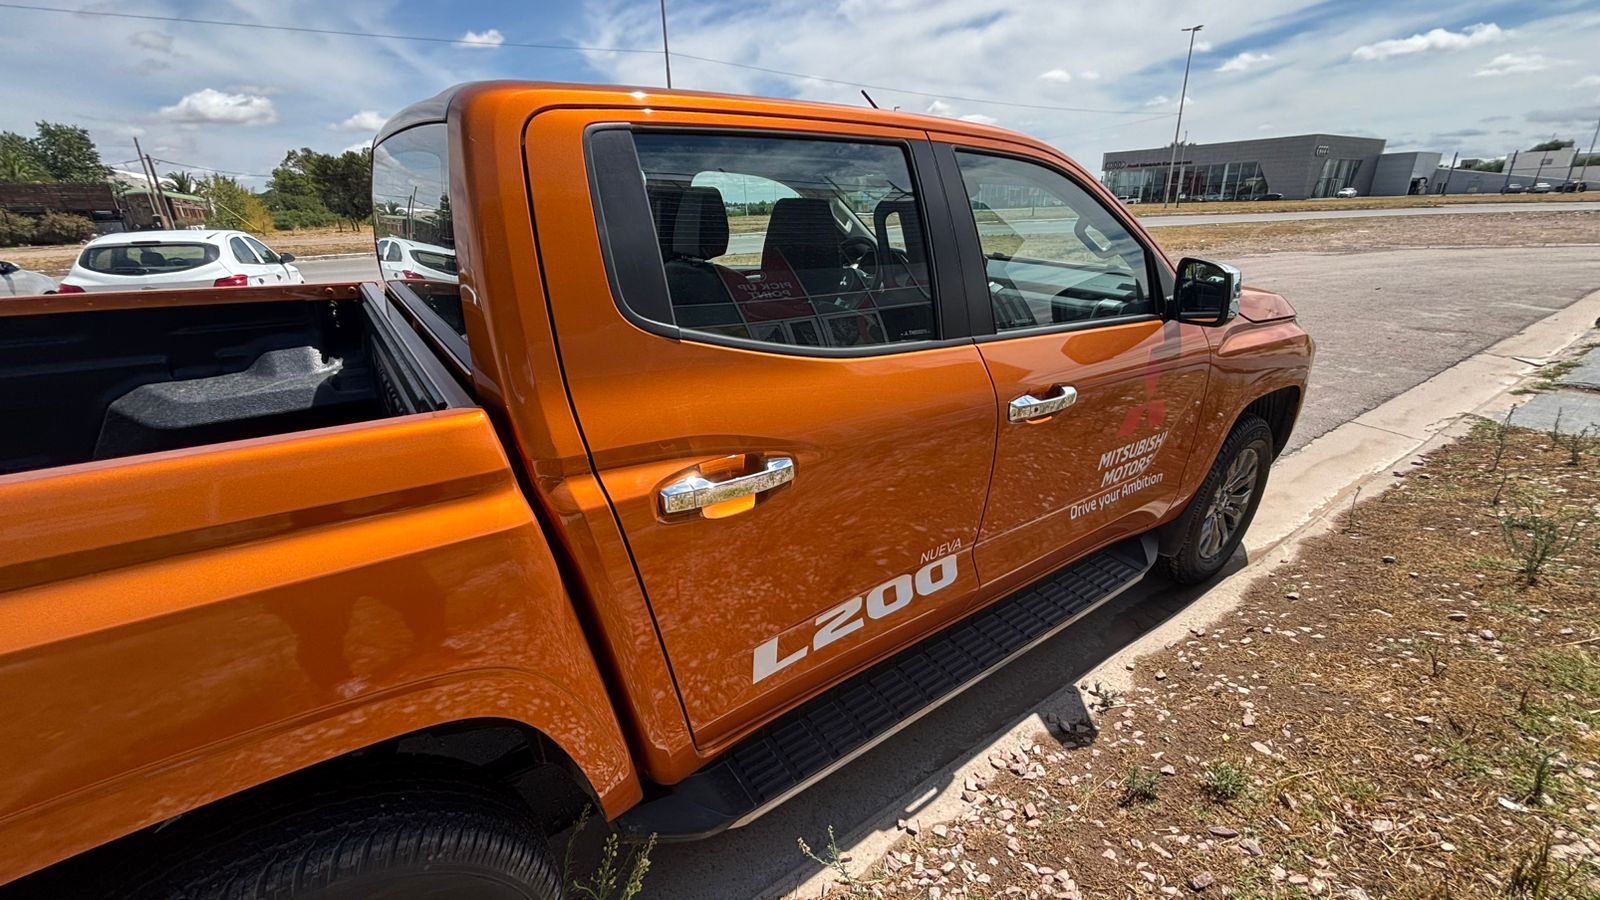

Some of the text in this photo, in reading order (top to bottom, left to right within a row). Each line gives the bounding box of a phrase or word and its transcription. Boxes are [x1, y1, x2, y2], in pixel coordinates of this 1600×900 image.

[1098, 431, 1168, 471] MITSUBISHI
[1101, 454, 1153, 488] MOTORS
[1070, 473, 1163, 520] Drive your Ambition
[920, 538, 961, 564] NUEVA
[753, 554, 958, 684] L200
